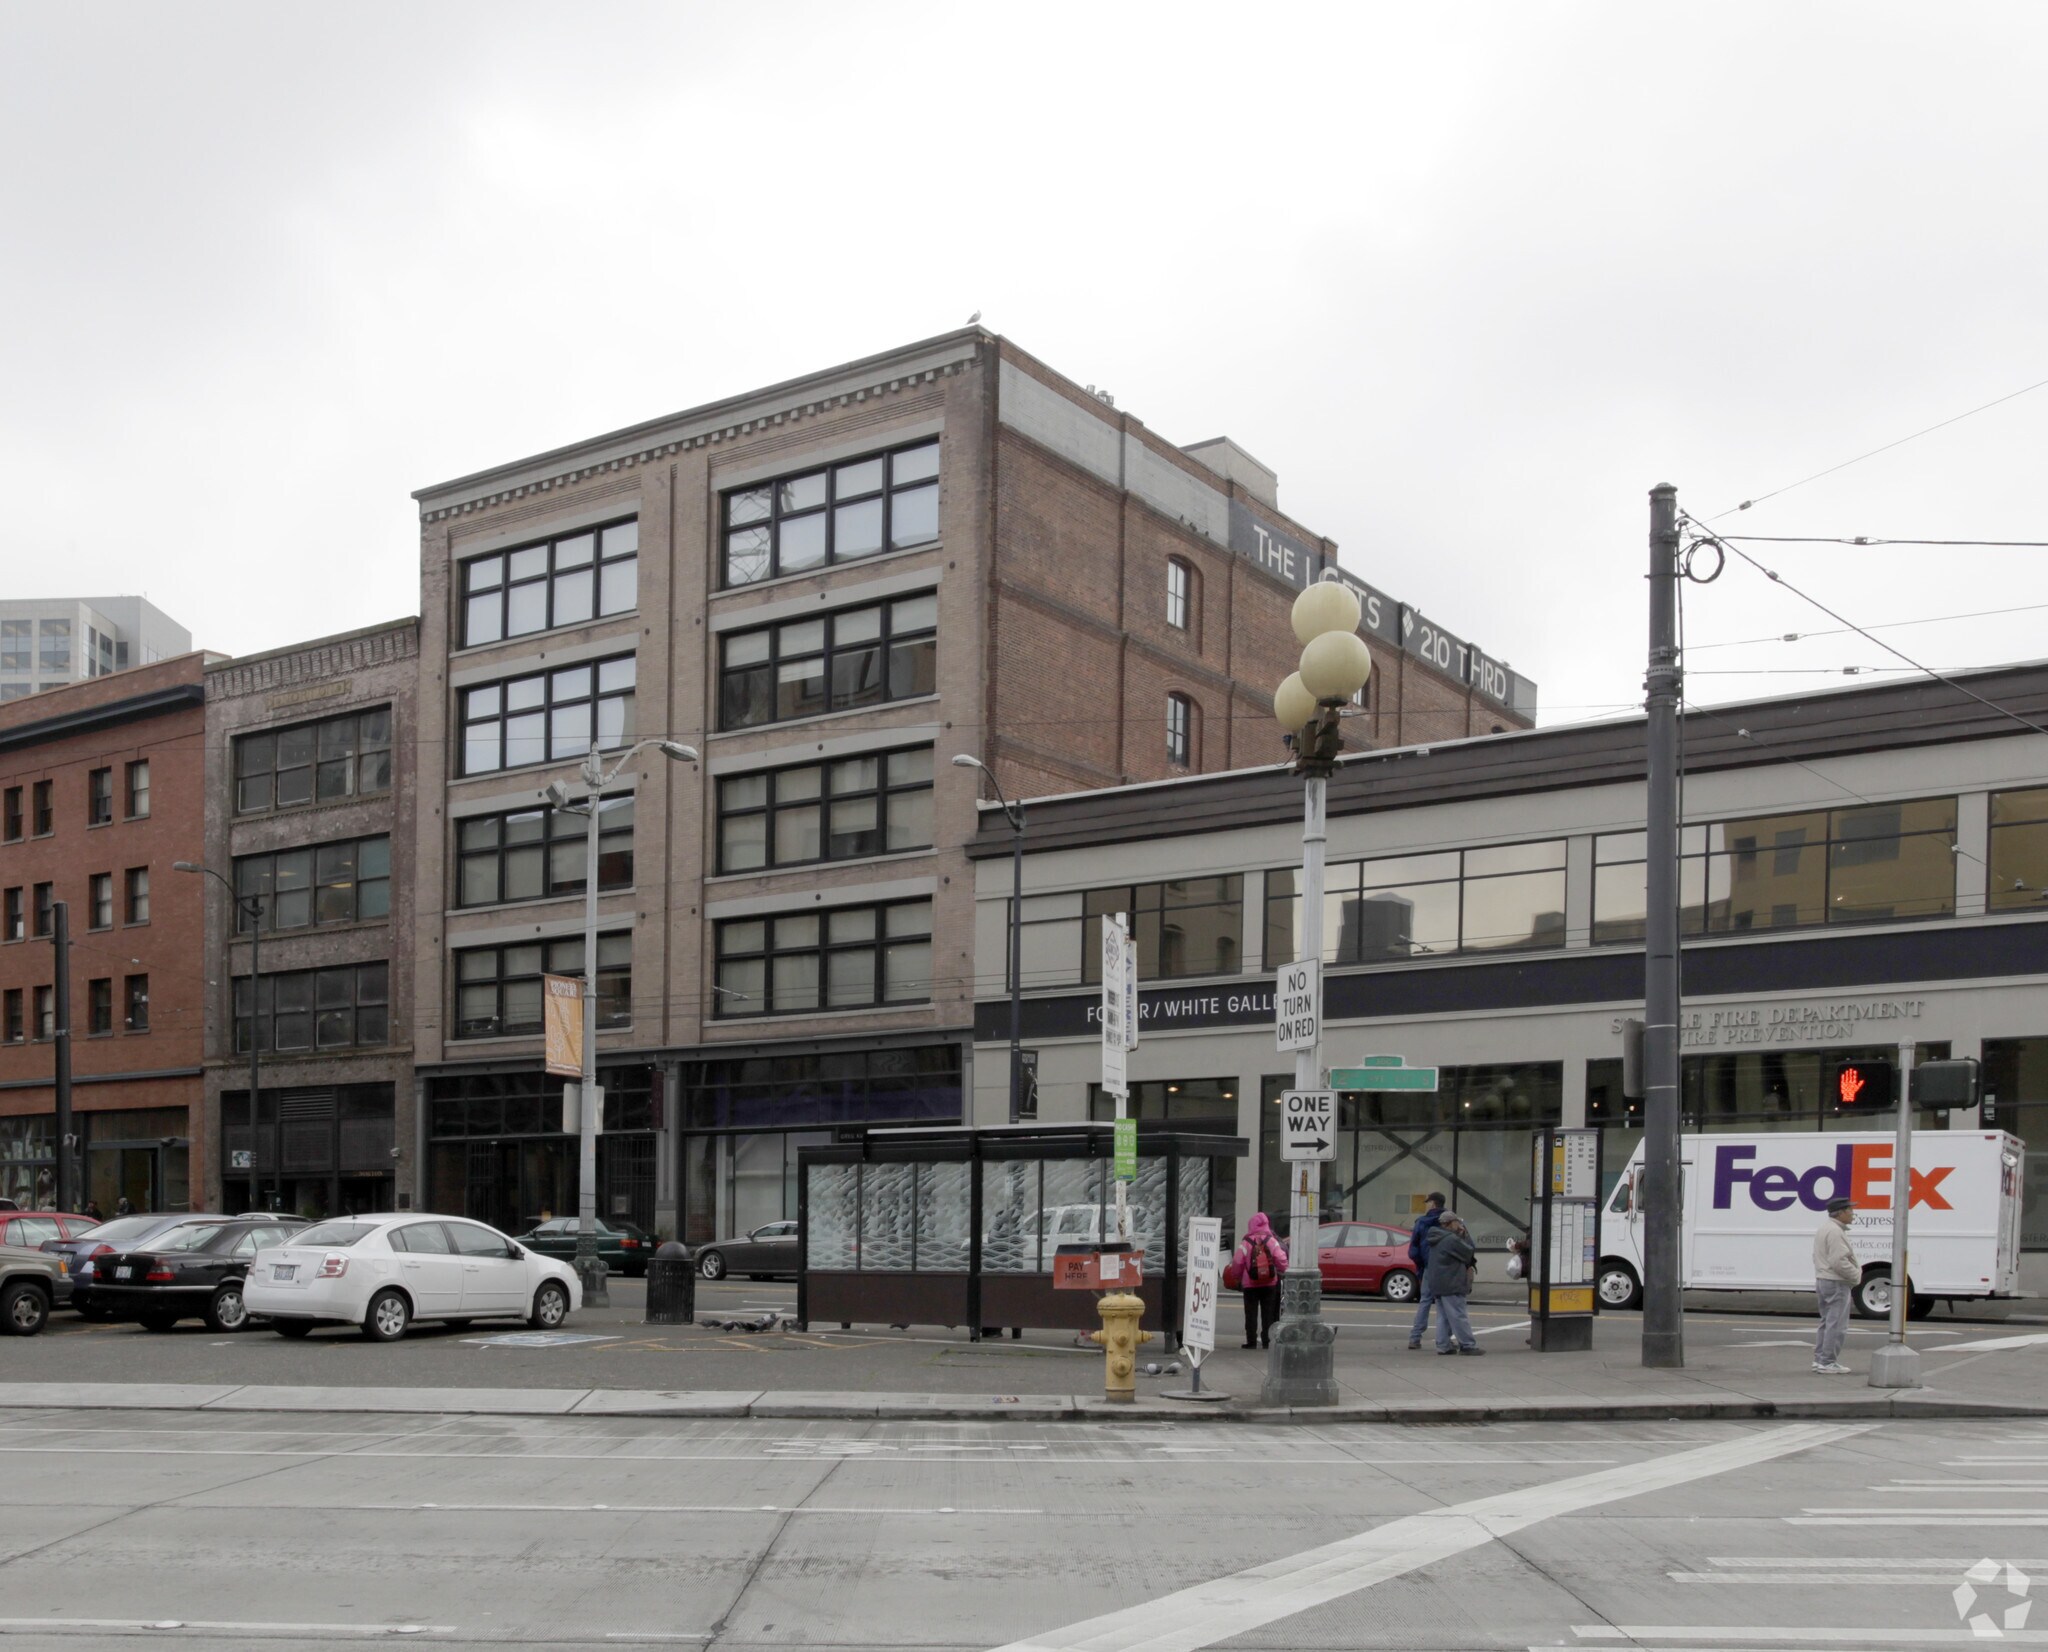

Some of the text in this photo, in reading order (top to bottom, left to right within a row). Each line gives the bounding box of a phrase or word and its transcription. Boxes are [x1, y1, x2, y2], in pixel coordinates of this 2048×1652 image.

[1253, 524, 1295, 581] THE
[1420, 626, 1450, 669] 210
[1457, 644, 1506, 700] THIRD
[1288, 971, 1306, 992] NO
[1228, 994, 1278, 1013] GALLE
[1283, 994, 1311, 1014] TURN
[1710, 1009, 1760, 1029] FIRE
[1768, 1000, 1925, 1025] DEPARTMENT
[1279, 1017, 1314, 1041] ON RED
[1728, 1023, 1853, 1045] PREVENTION
[1288, 1096, 1330, 1113] ONE
[1287, 1116, 1331, 1132] WAY
[1713, 1144, 1957, 1212] FedEx
[1068, 1262, 1084, 1272] PAY
